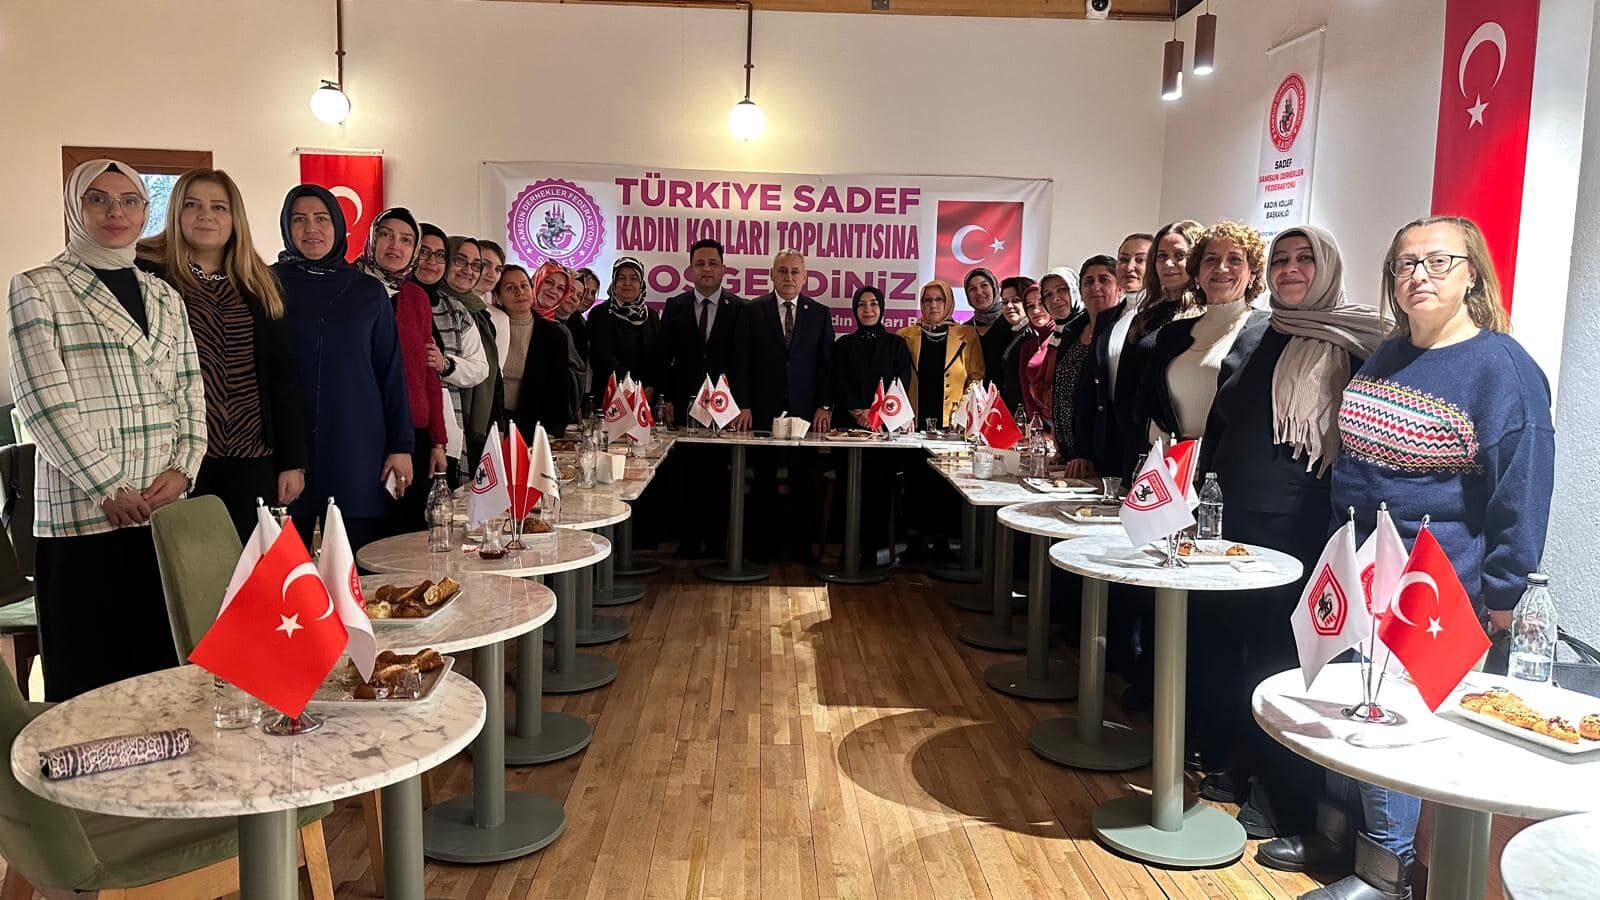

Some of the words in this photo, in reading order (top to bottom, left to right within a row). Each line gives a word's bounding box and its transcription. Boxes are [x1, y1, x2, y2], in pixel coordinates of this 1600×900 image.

[1274, 158, 1292, 170] SADEF
[522, 188, 567, 211] DERNEKLER
[793, 185, 921, 214] SADEF
[517, 213, 529, 246] SAMSUN
[568, 192, 595, 249] FEDERASYONU
[615, 215, 680, 253] KADIN
[777, 221, 920, 260] TOPLANTISINA
